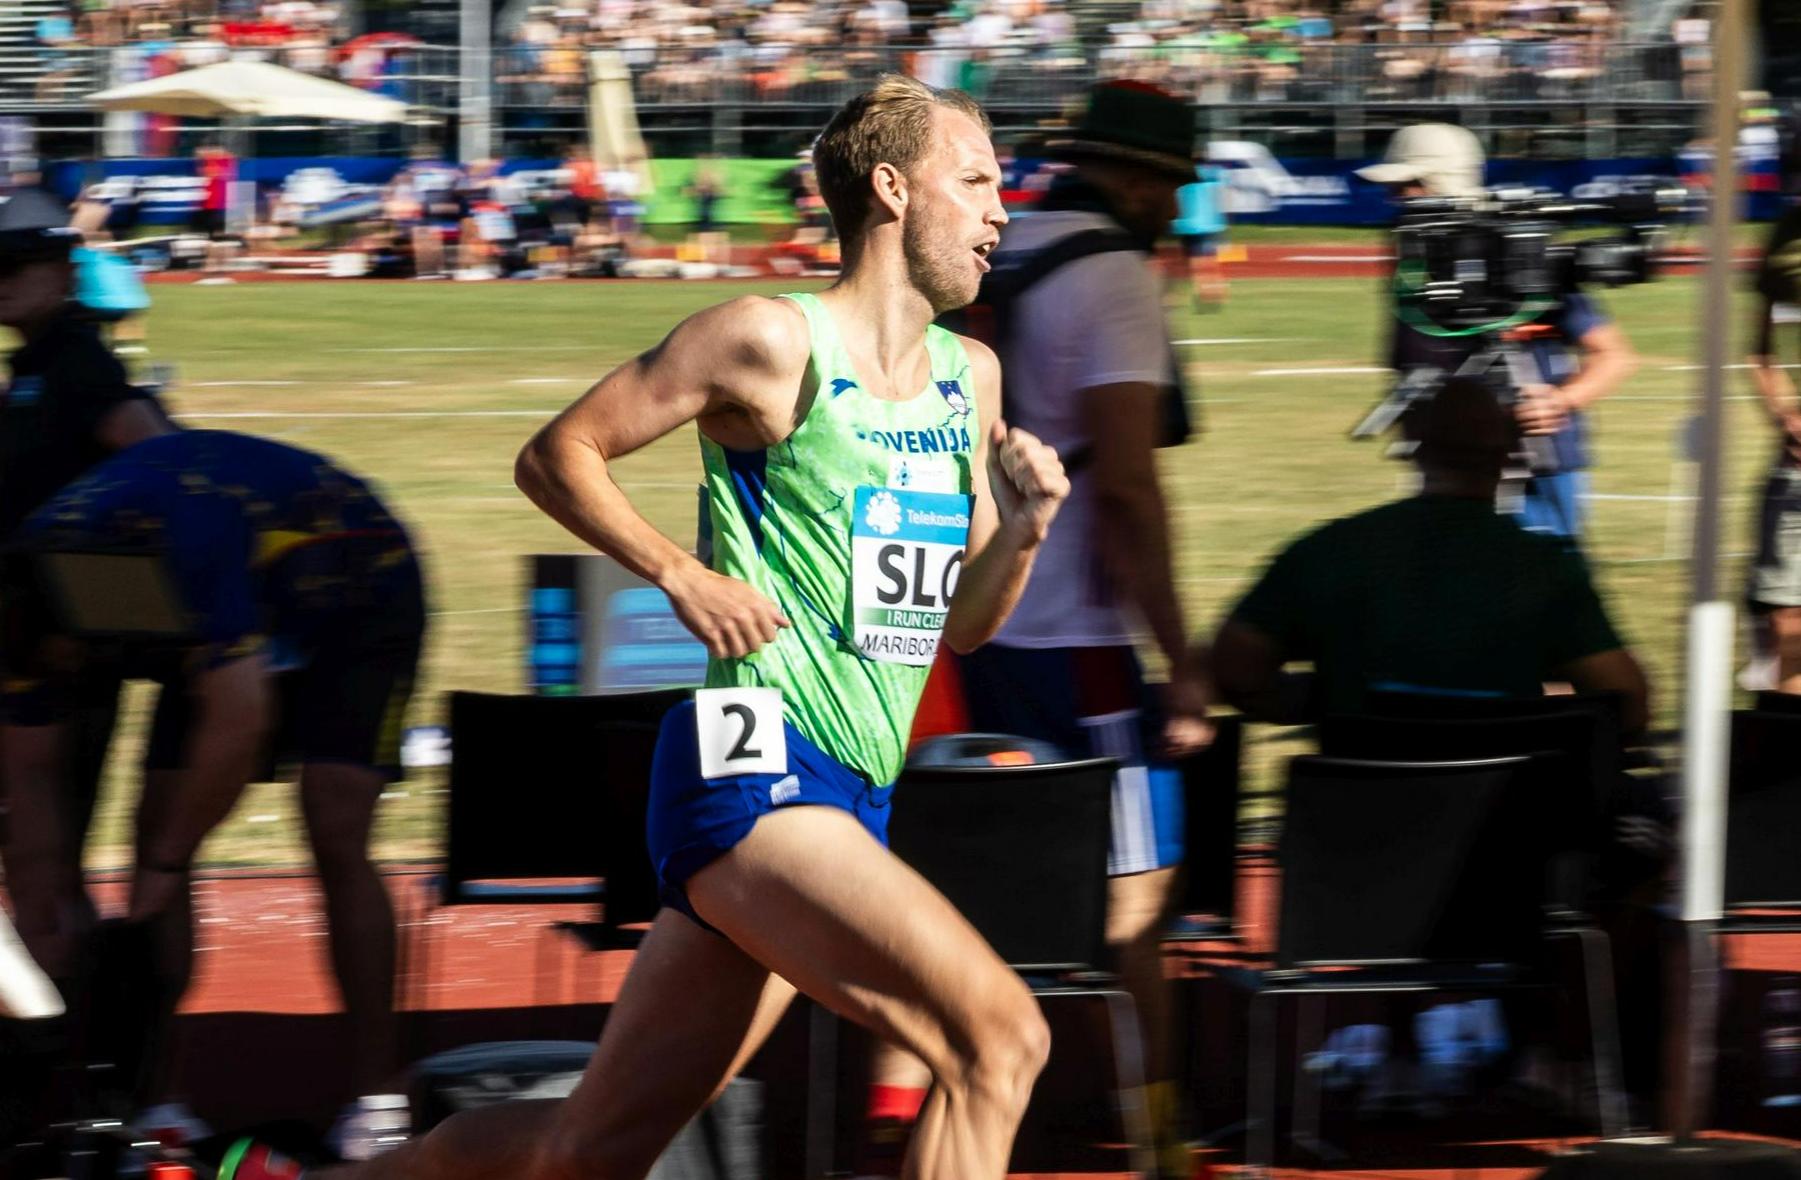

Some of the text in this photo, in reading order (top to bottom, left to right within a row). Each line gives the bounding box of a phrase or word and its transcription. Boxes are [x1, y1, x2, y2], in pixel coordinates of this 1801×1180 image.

[851, 425, 972, 453] OVENIJA
[893, 611, 921, 627] RUN
[721, 703, 763, 762] 2
